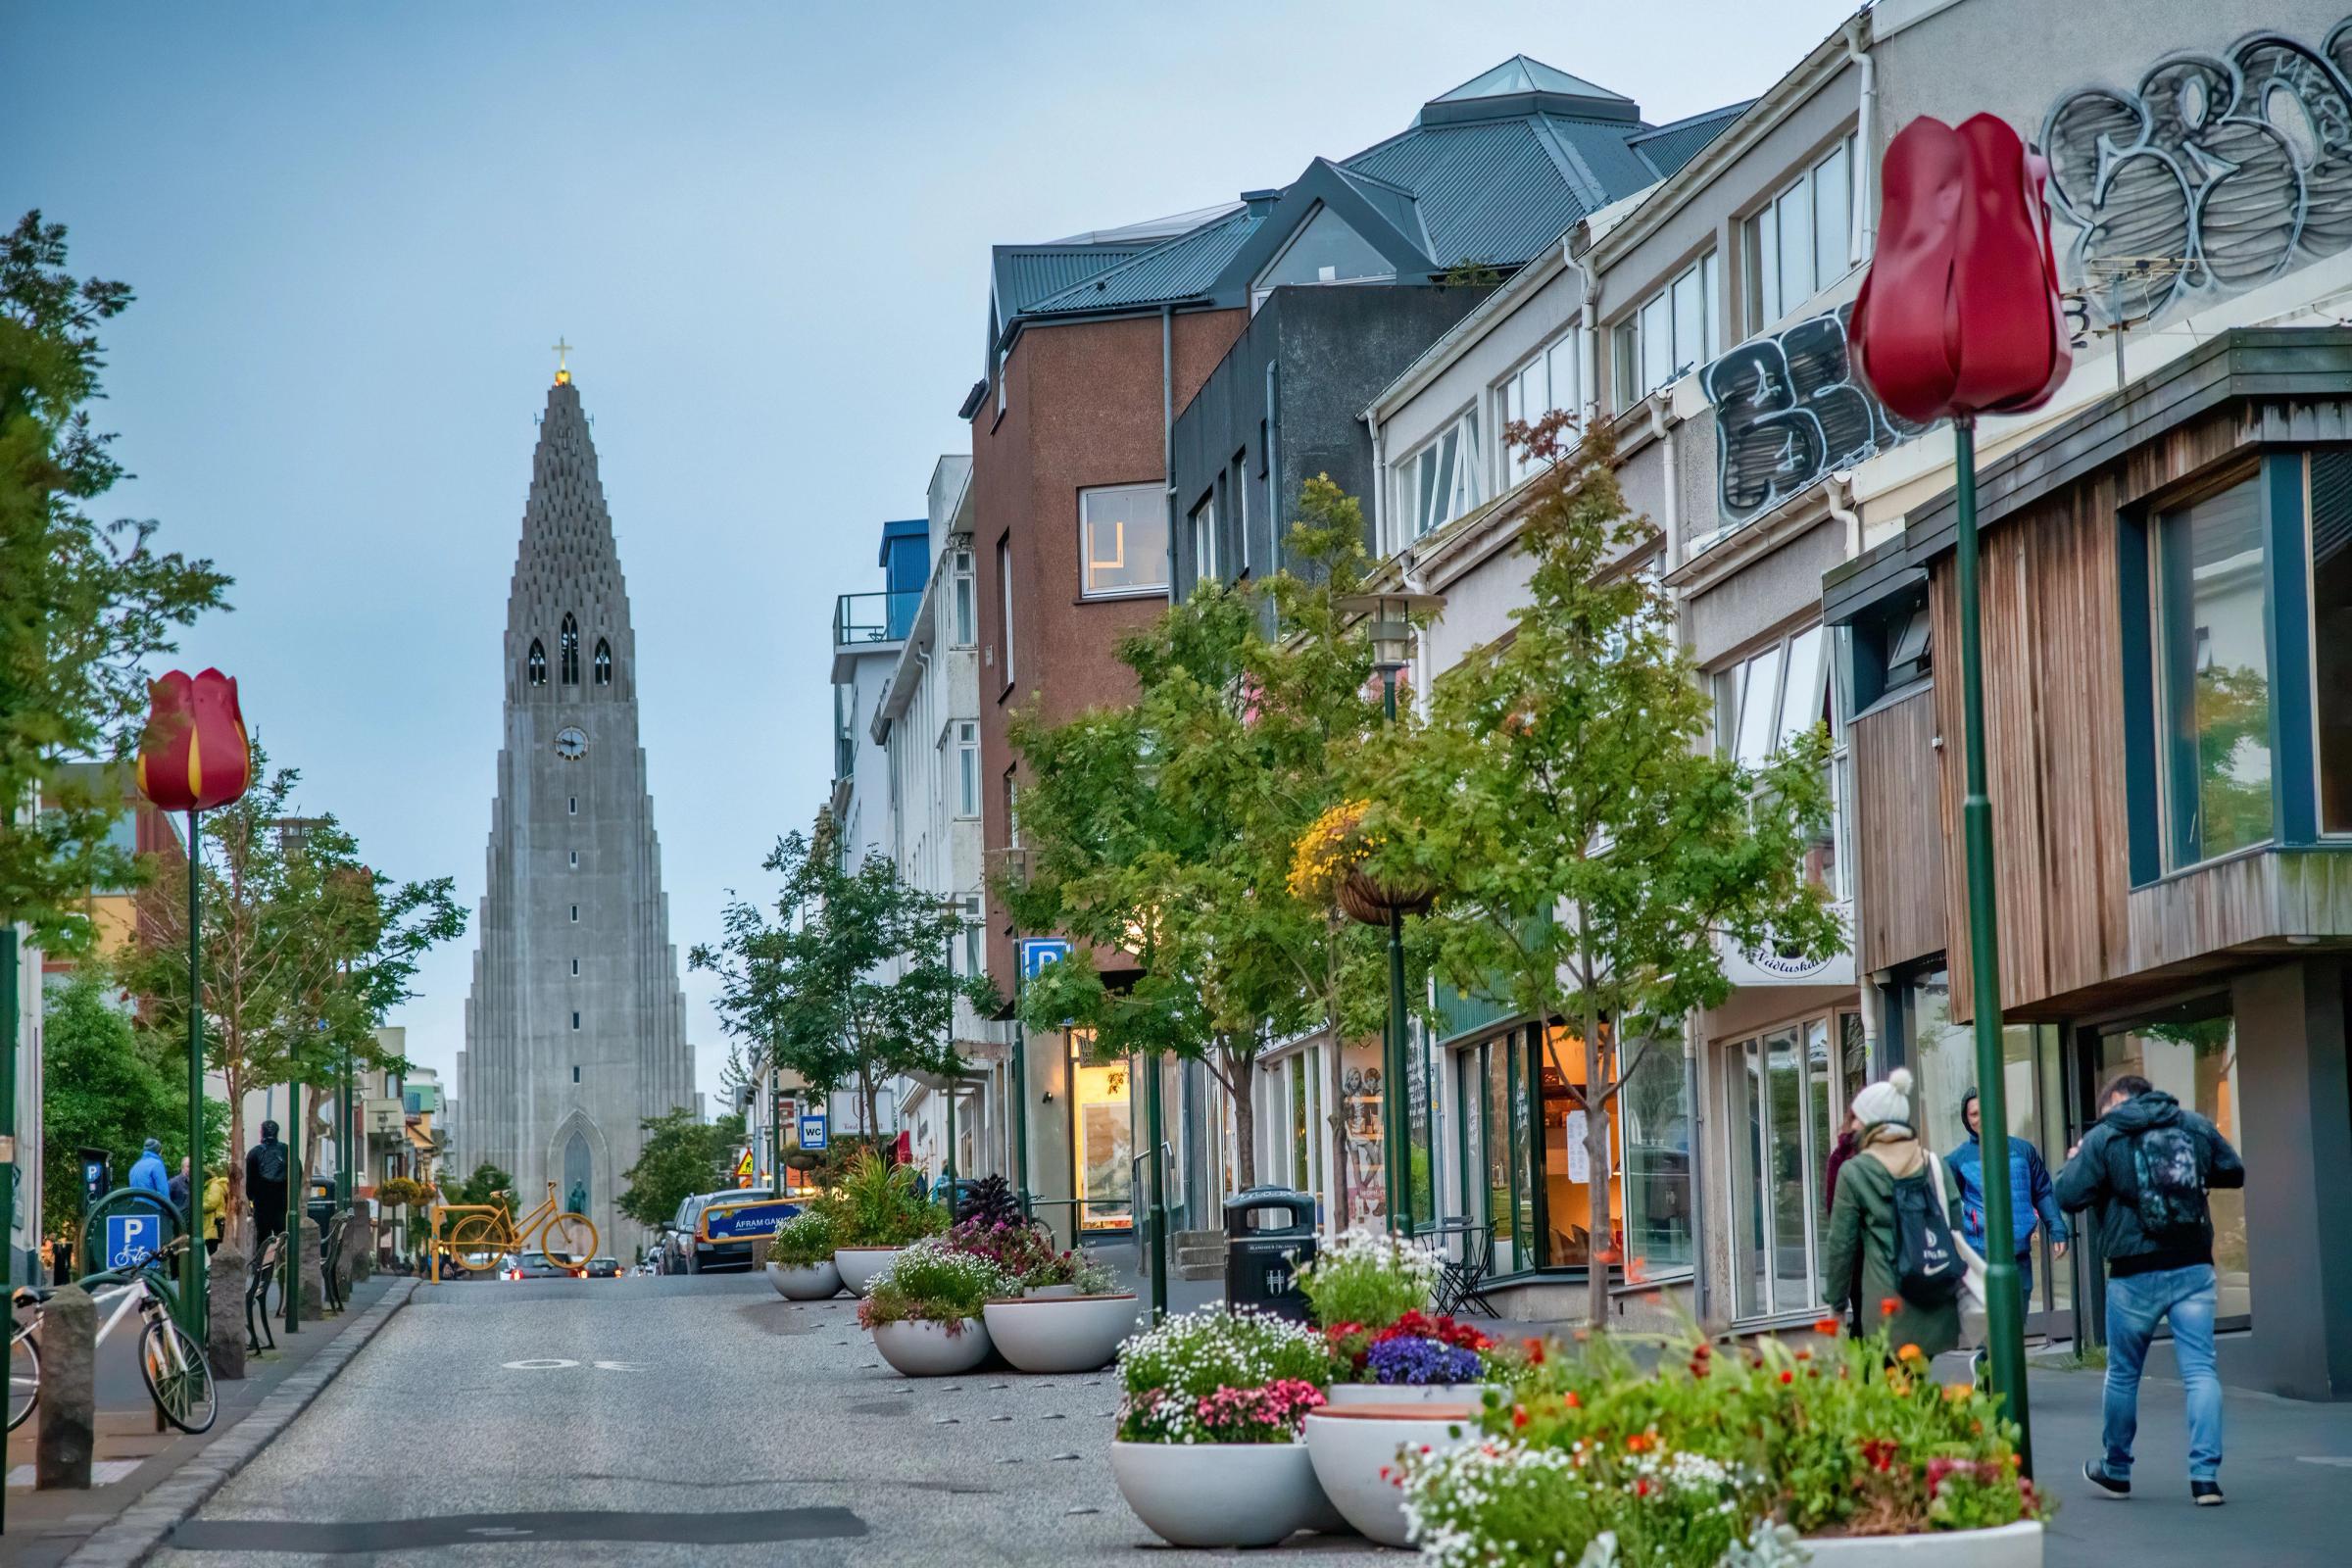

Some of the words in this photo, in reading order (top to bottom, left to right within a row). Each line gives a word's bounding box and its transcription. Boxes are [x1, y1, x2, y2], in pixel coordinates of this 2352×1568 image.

[806, 1128, 821, 1137] WC
[87, 1165, 97, 1179] P
[735, 1218, 763, 1229] ÁFRAM
[124, 1218, 143, 1244] P
